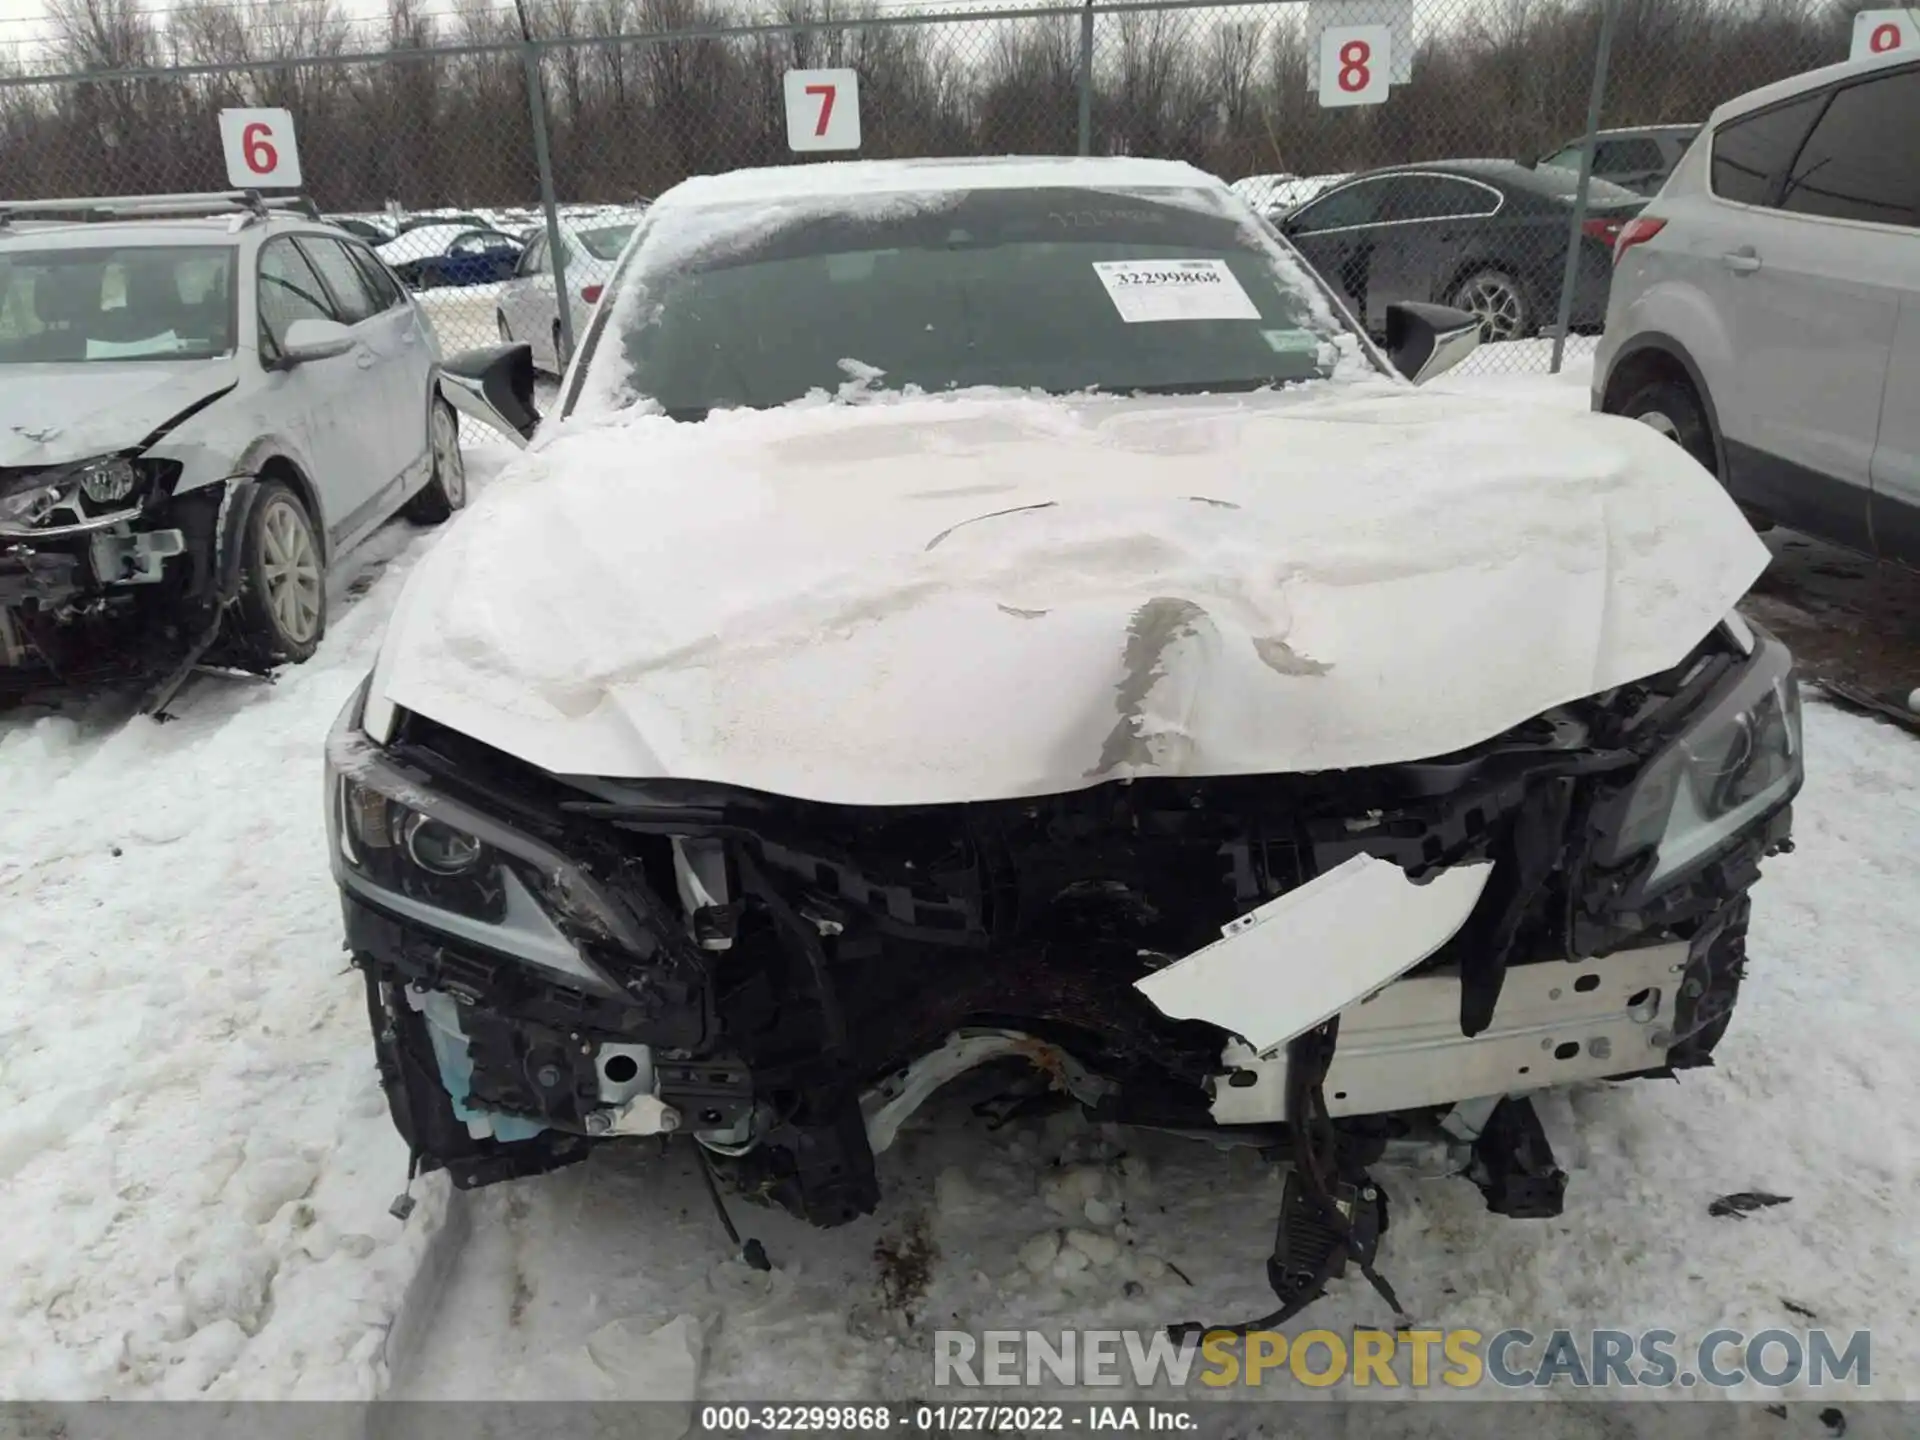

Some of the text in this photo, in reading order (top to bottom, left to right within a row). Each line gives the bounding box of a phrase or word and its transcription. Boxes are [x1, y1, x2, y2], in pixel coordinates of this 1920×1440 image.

[1338, 40, 1370, 92] 8
[805, 85, 836, 136] 7
[243, 122, 278, 174] 6
[1114, 270, 1221, 286] 32299868
